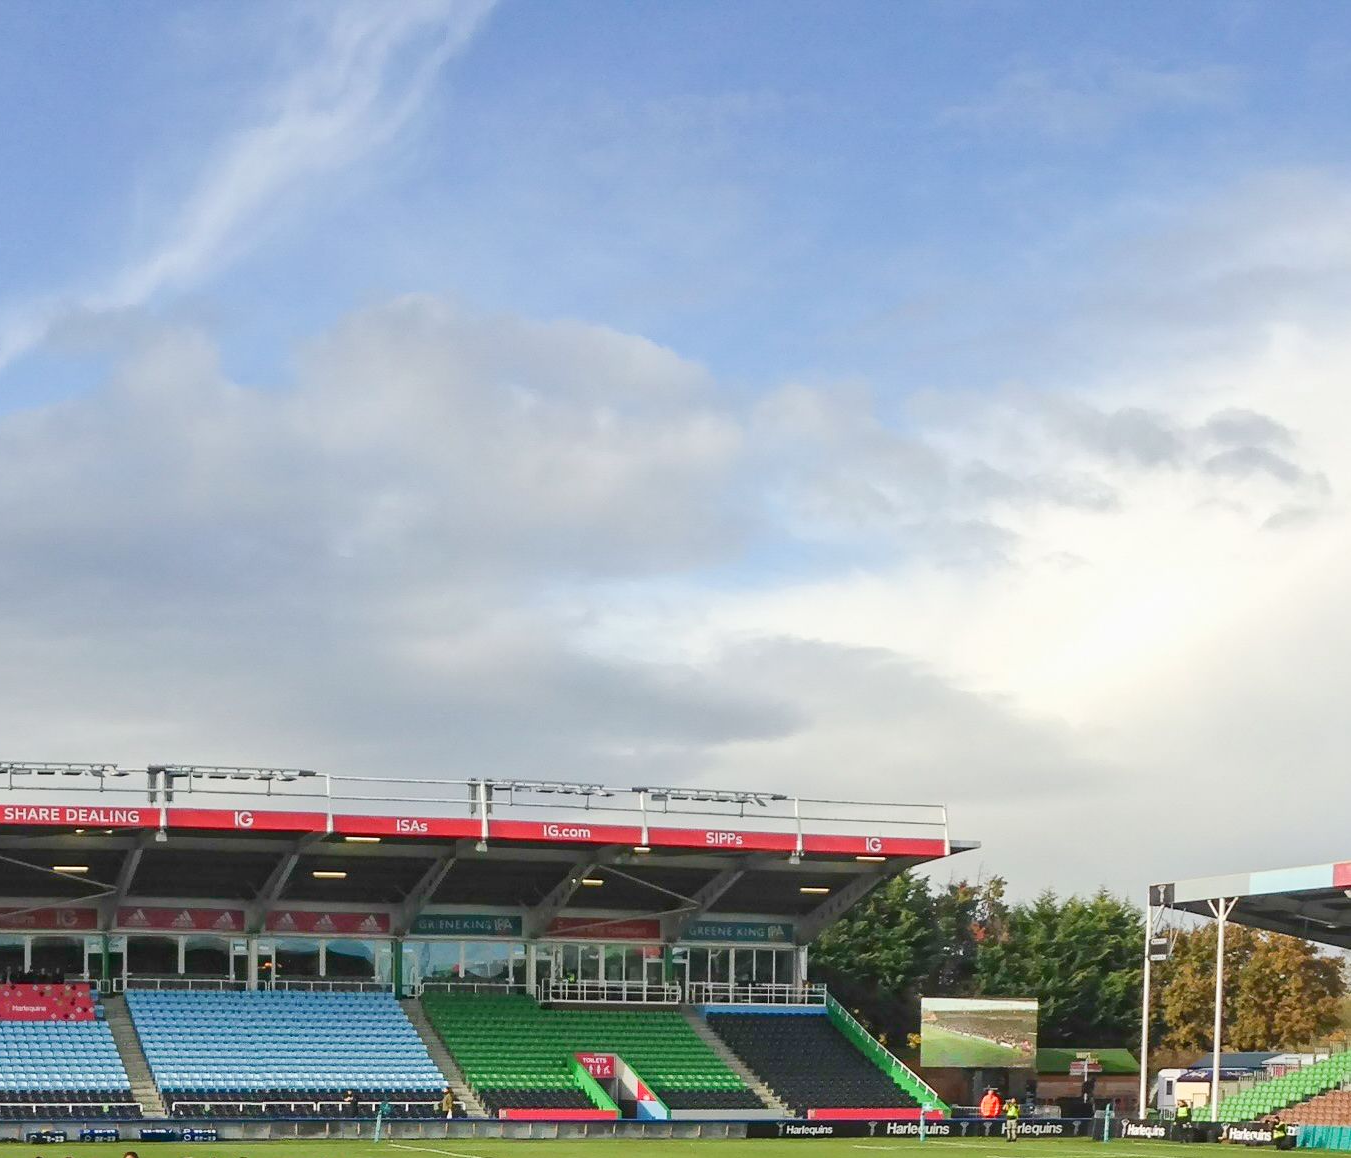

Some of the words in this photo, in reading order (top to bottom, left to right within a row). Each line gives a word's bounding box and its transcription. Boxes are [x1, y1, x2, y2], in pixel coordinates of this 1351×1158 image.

[4, 807, 60, 822] SHARE
[65, 808, 140, 824] DEALING
[234, 811, 254, 828] IG
[395, 818, 428, 833] ISAs
[542, 823, 591, 839] IG.com
[705, 831, 743, 846] SIPPs
[865, 837, 881, 852] IG
[688, 923, 734, 936] GREENE
[786, 1124, 833, 1136] Harlequins
[1127, 1124, 1166, 1138] Harlequins
